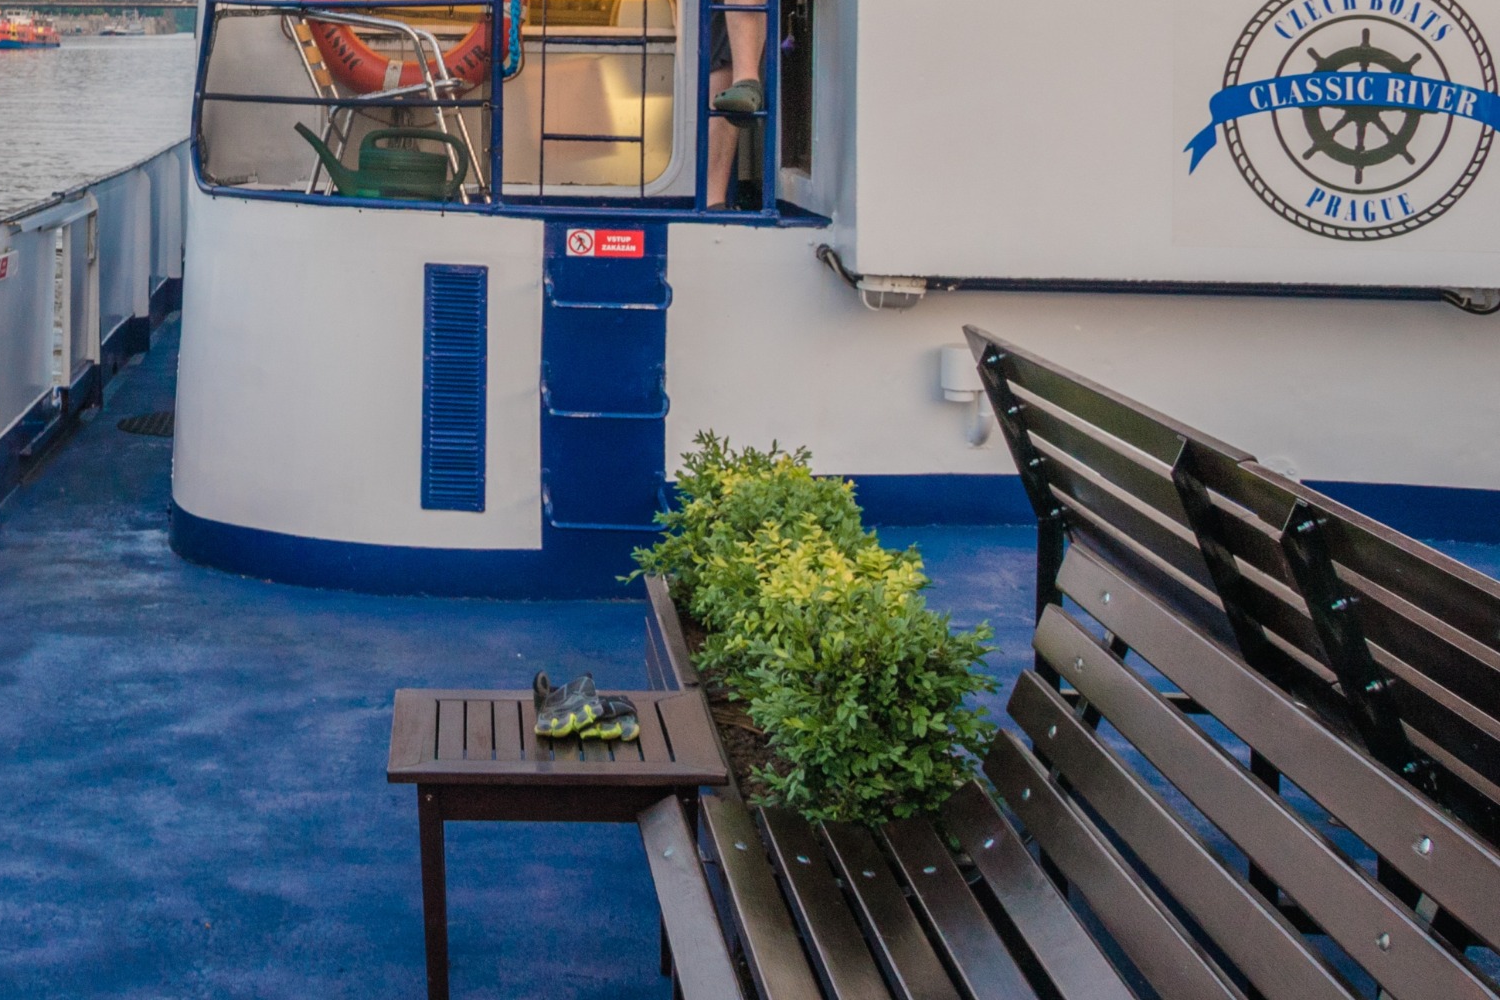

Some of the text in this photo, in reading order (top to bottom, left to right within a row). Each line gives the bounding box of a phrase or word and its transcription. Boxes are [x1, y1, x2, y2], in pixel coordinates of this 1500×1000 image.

[1249, 76, 1478, 117] CLASSIC RIVER
[1305, 187, 1415, 223] PRAGUE
[601, 243, 636, 252] ZAKÁZÁN
[606, 235, 632, 243] VSTUP
